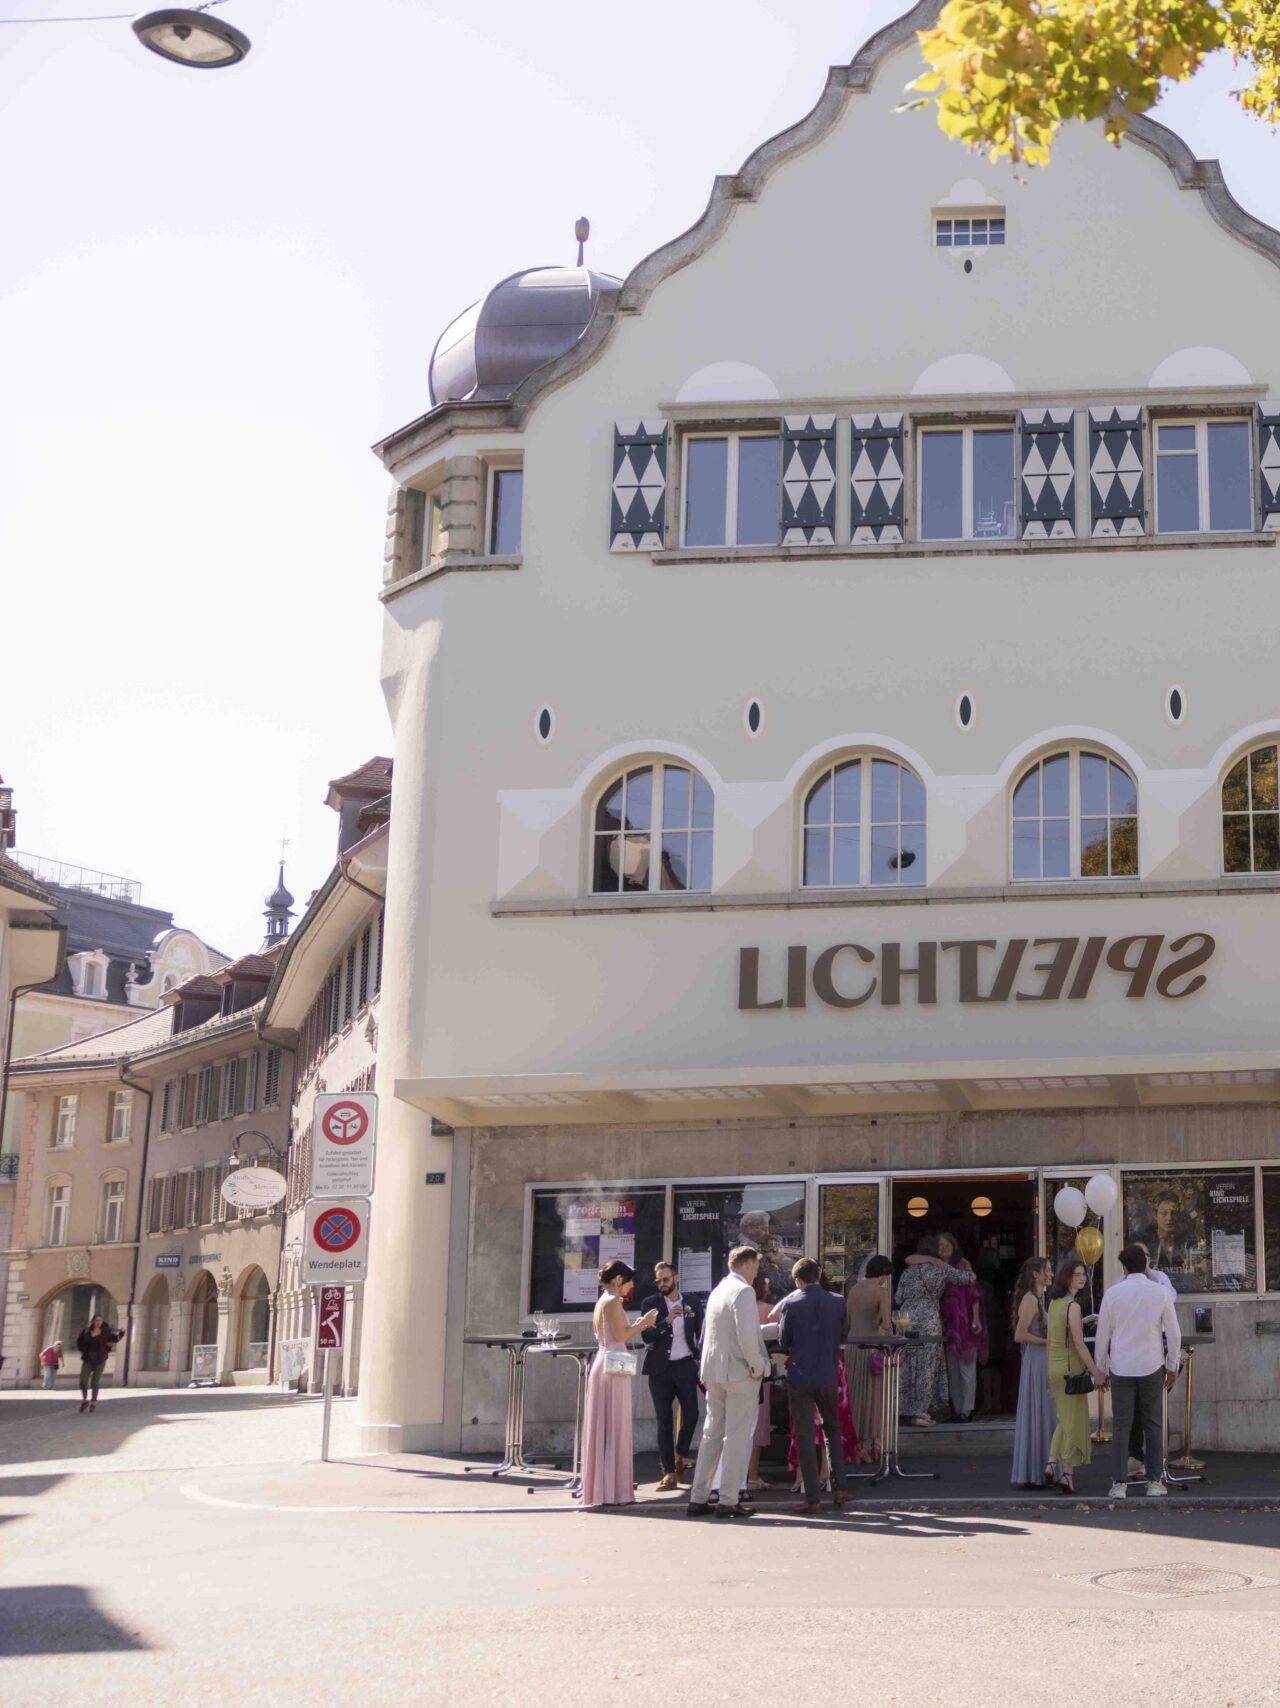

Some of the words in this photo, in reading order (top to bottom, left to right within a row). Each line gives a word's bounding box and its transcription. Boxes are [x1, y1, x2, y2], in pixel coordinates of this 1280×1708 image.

[738, 943, 997, 1009] LICHT
[568, 1204, 626, 1217] Programm
[309, 1259, 361, 1271] Wendeplatz
